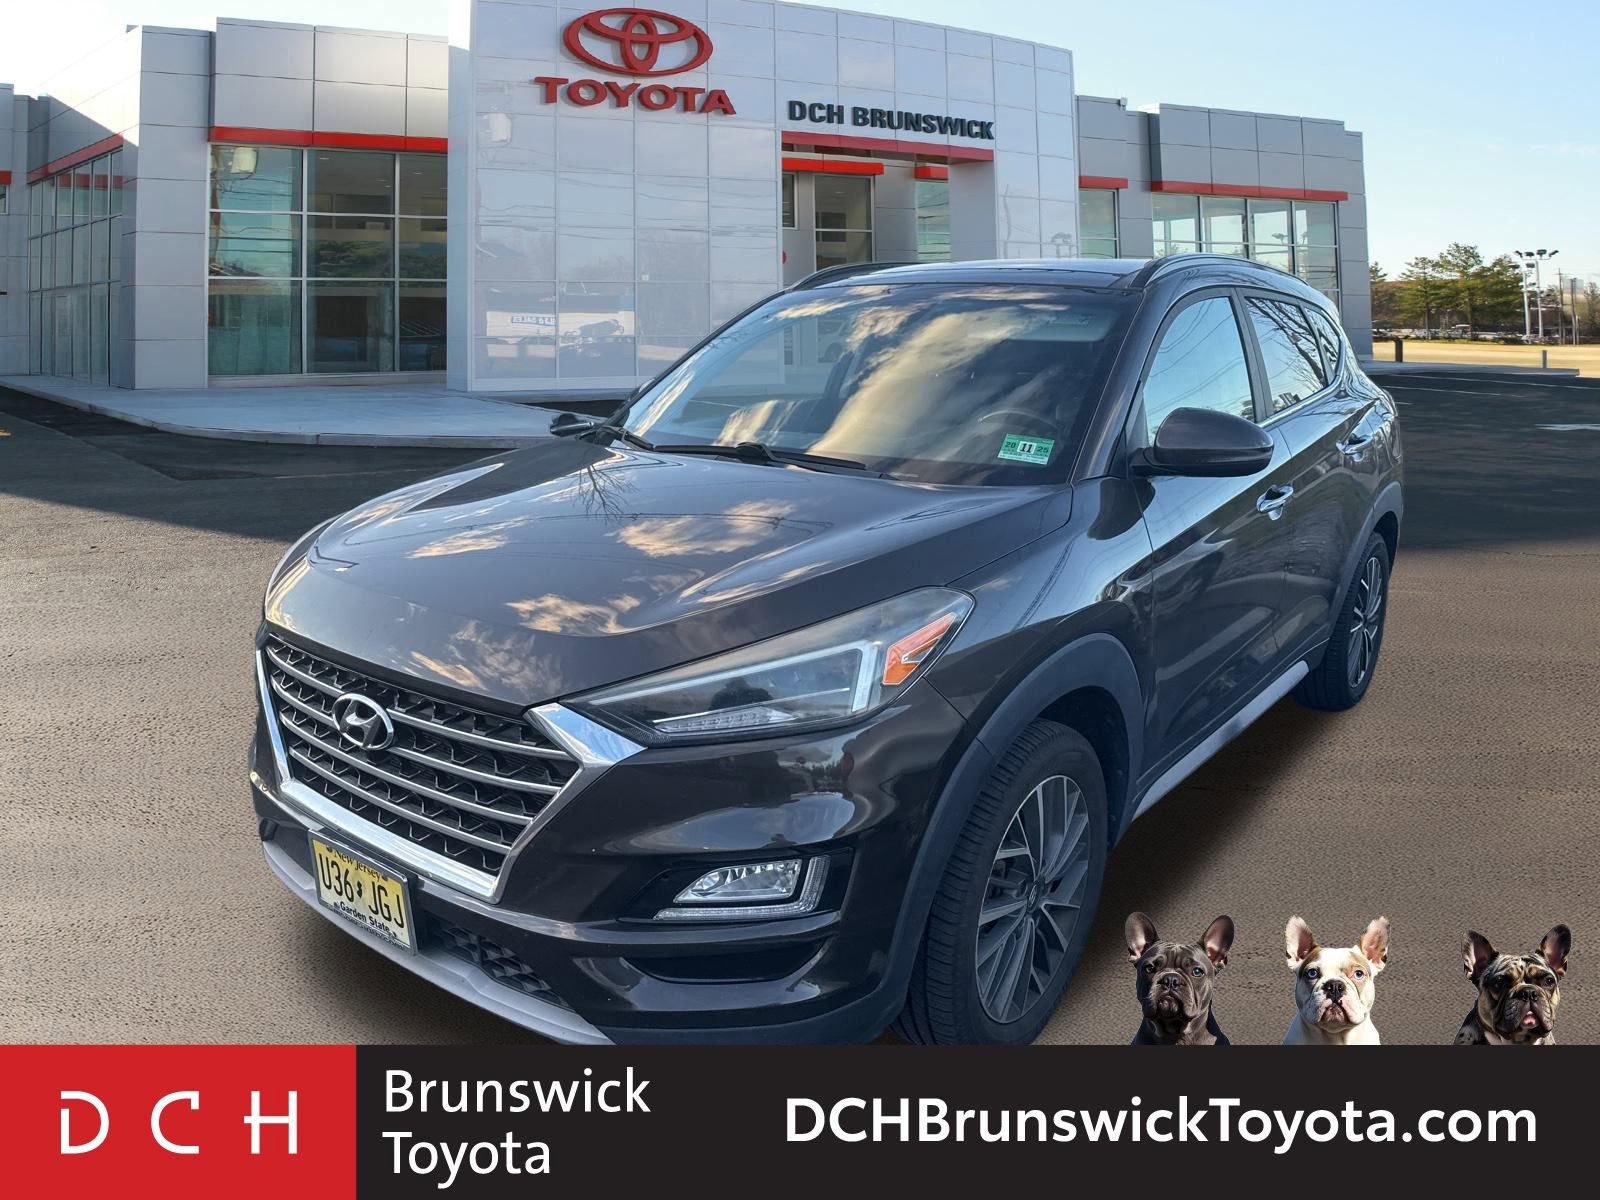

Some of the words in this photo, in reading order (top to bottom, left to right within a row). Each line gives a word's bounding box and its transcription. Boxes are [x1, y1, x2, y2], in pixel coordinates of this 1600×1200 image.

[534, 76, 736, 115] TOYOTA
[788, 100, 845, 126] DCH
[852, 108, 995, 140] BRUNSWICK
[1005, 441, 1017, 449] 20
[1020, 443, 1033, 453] 11
[1037, 446, 1049, 454] 25
[319, 853, 355, 903] U36
[368, 881, 405, 929] JGJ
[339, 901, 367, 922] Garden
[368, 915, 391, 933] State
